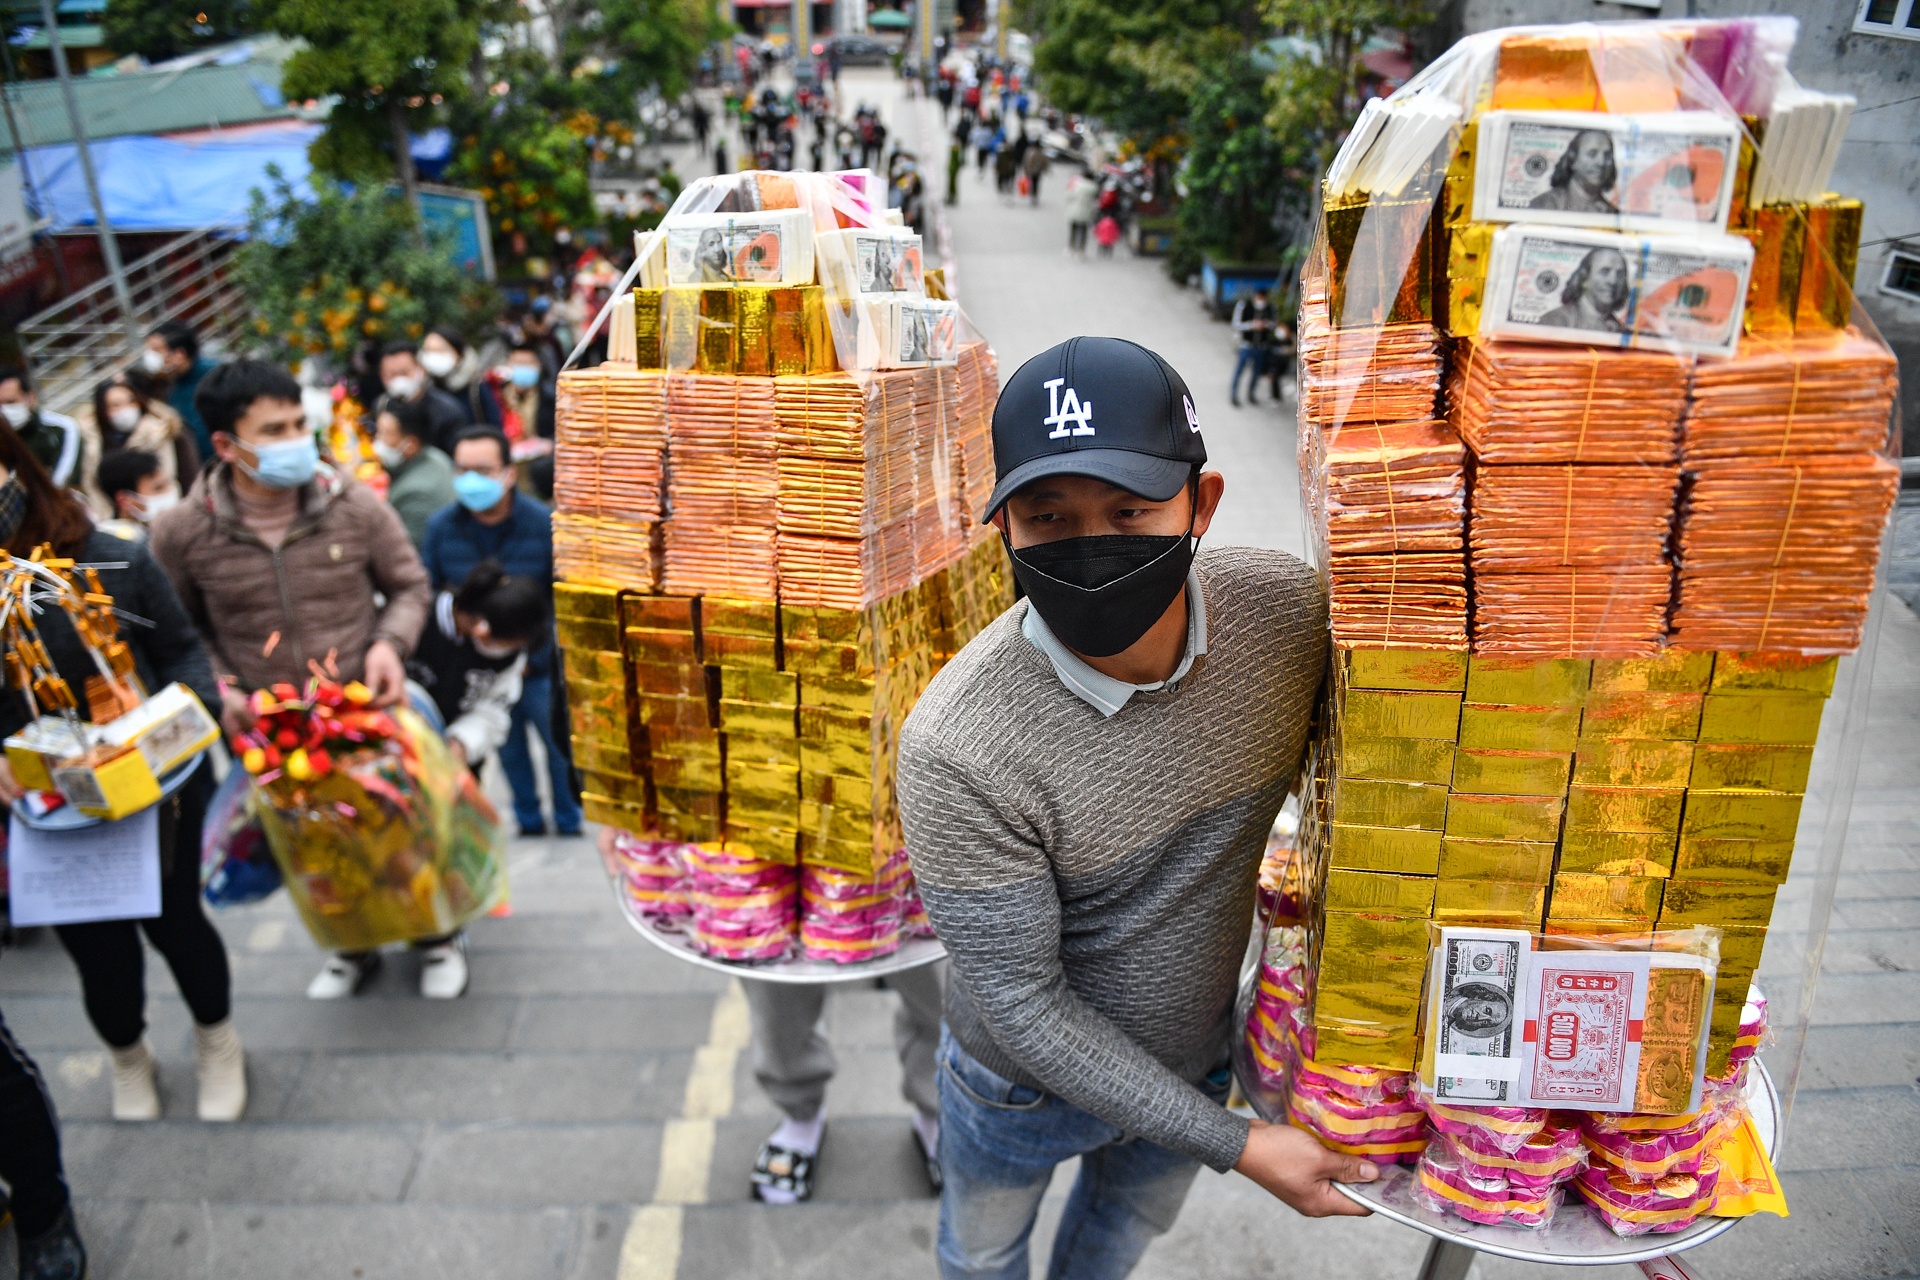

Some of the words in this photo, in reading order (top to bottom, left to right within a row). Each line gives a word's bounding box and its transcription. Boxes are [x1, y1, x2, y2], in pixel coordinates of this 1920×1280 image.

[1043, 378, 1096, 440] LA
[1448, 944, 1459, 976] 100
[1548, 1014, 1575, 1058] 500.000
